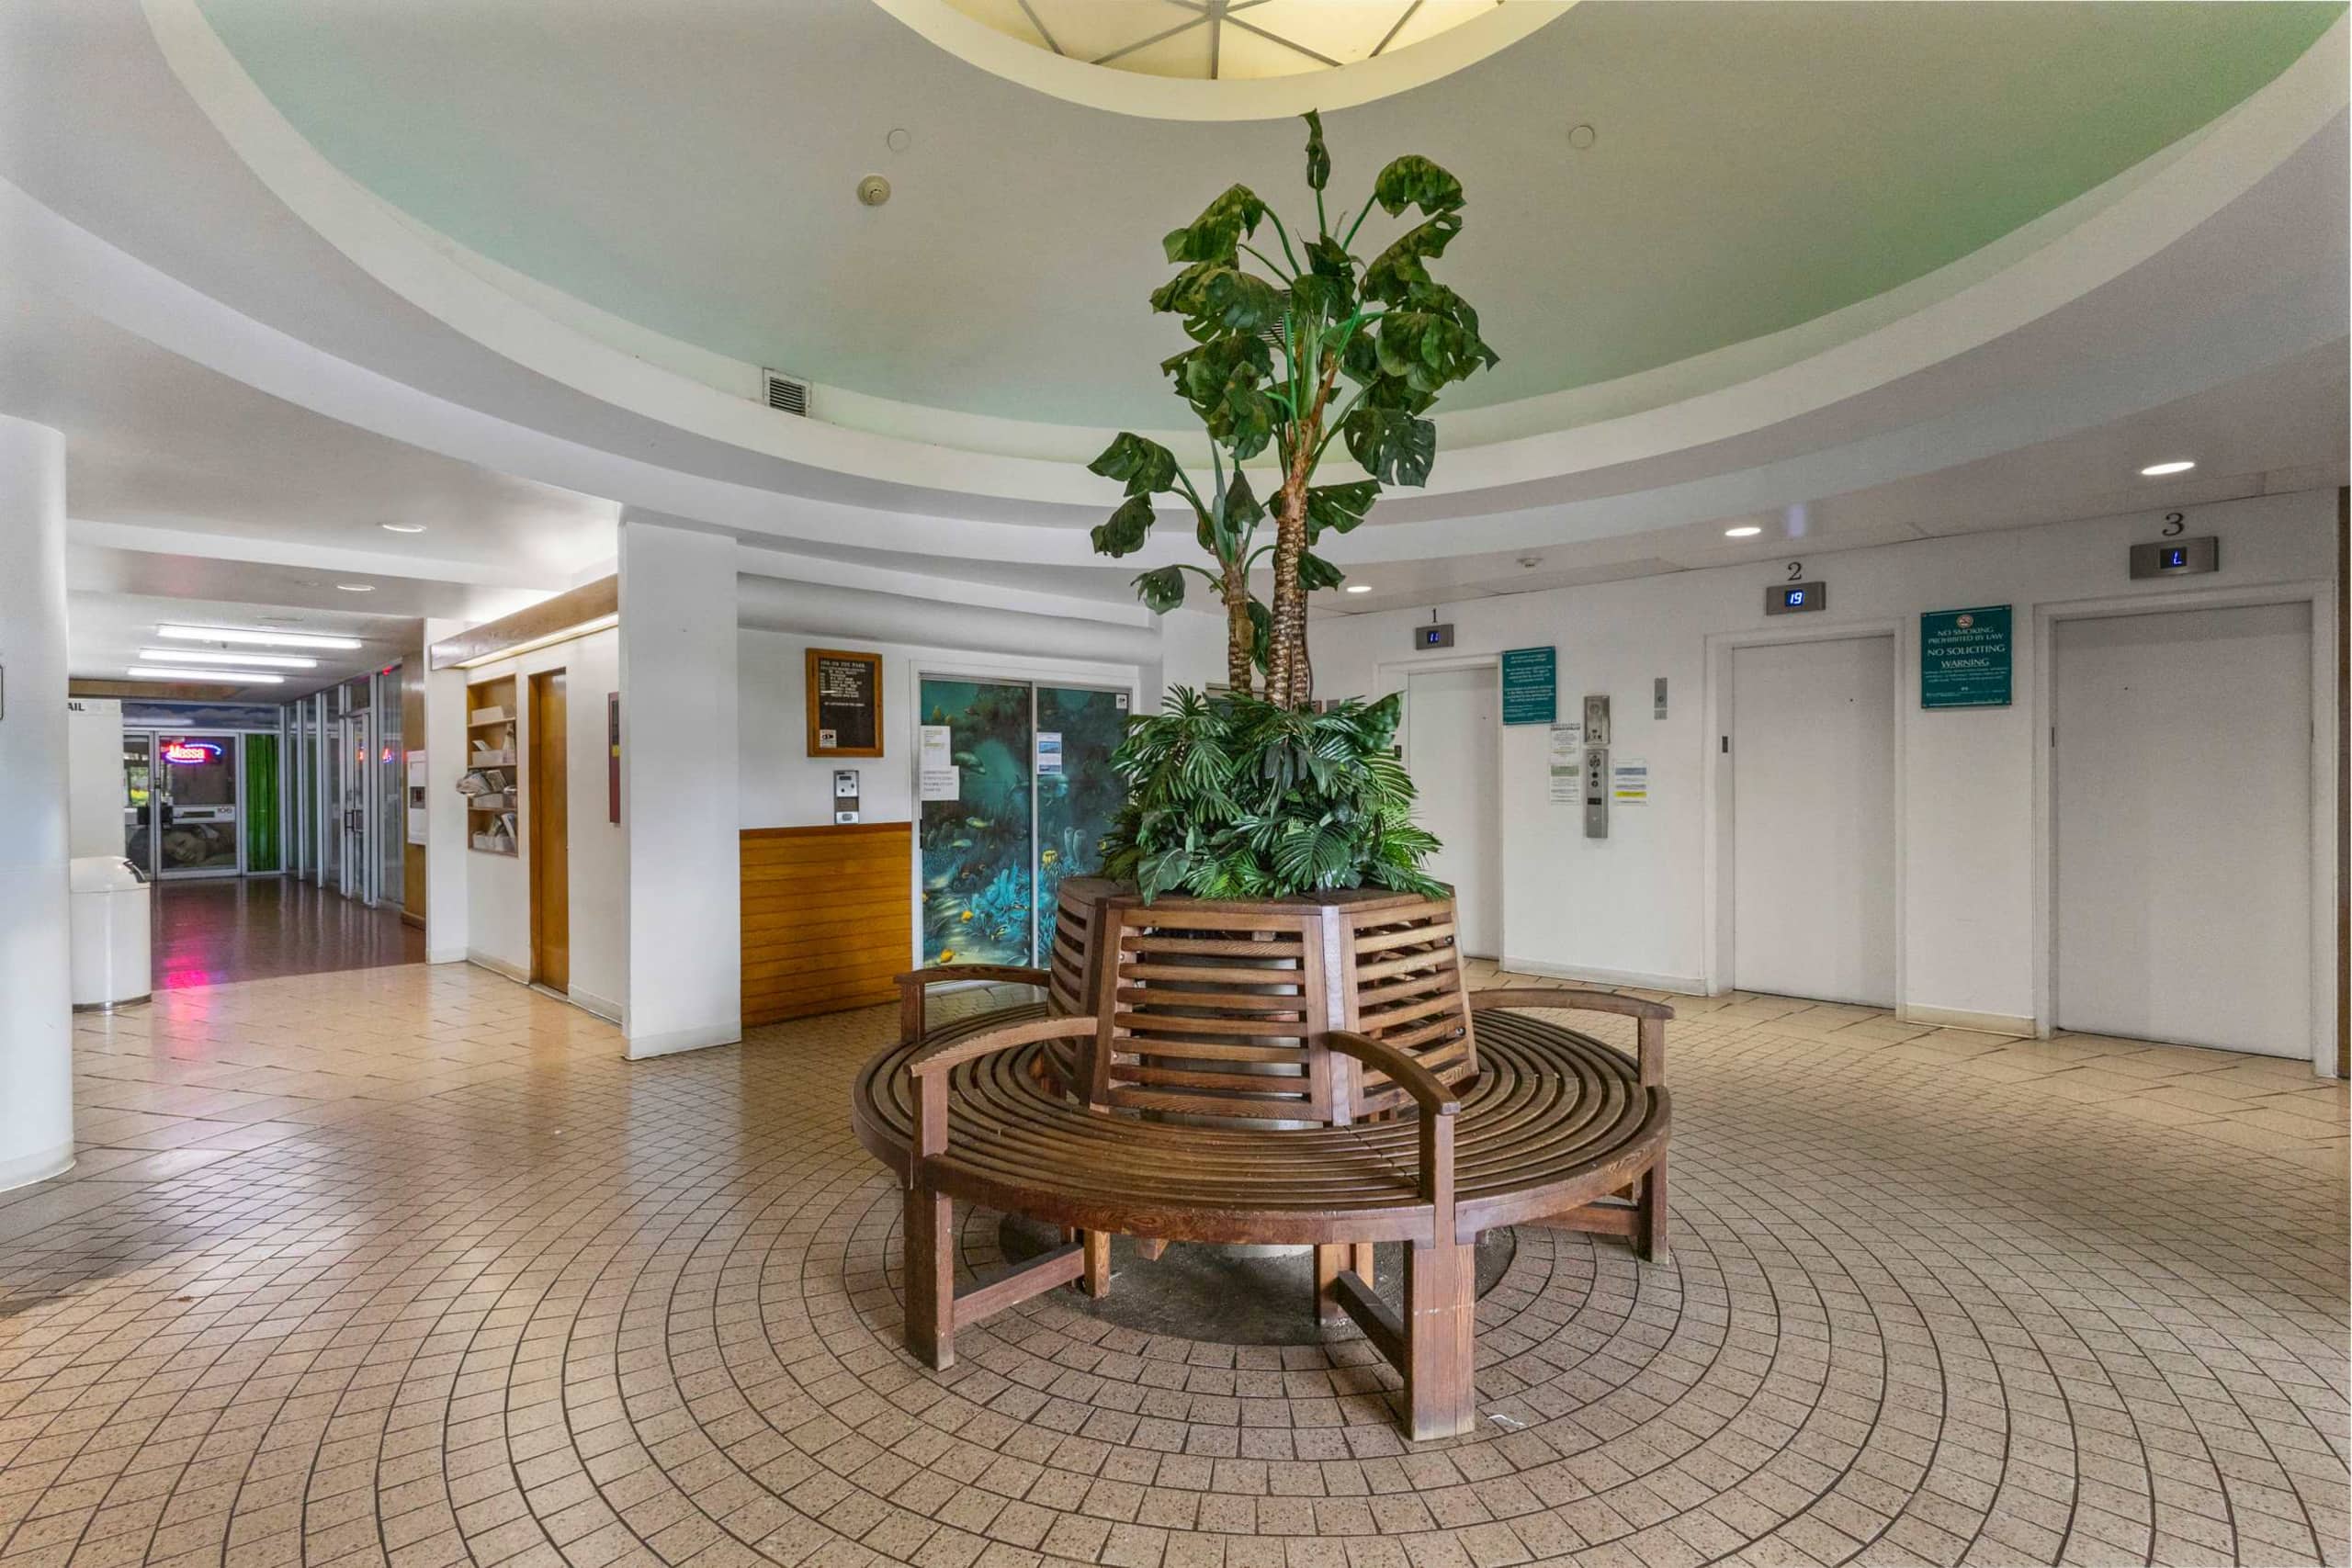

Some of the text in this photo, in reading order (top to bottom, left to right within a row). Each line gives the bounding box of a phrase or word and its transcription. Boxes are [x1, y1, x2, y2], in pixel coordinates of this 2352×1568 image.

[2162, 513, 2185, 536] 3
[2173, 551, 2182, 564] L
[1787, 561, 1803, 581] 2
[1790, 592, 1804, 605] 19
[1431, 607, 1438, 623] 1
[1952, 626, 1993, 635] SMOKING
[1928, 635, 1973, 644] PROHIBITED
[1986, 632, 2004, 640] LAW
[1927, 644, 2006, 657] NO SOLICITING
[1940, 658, 1990, 669] WARNING
